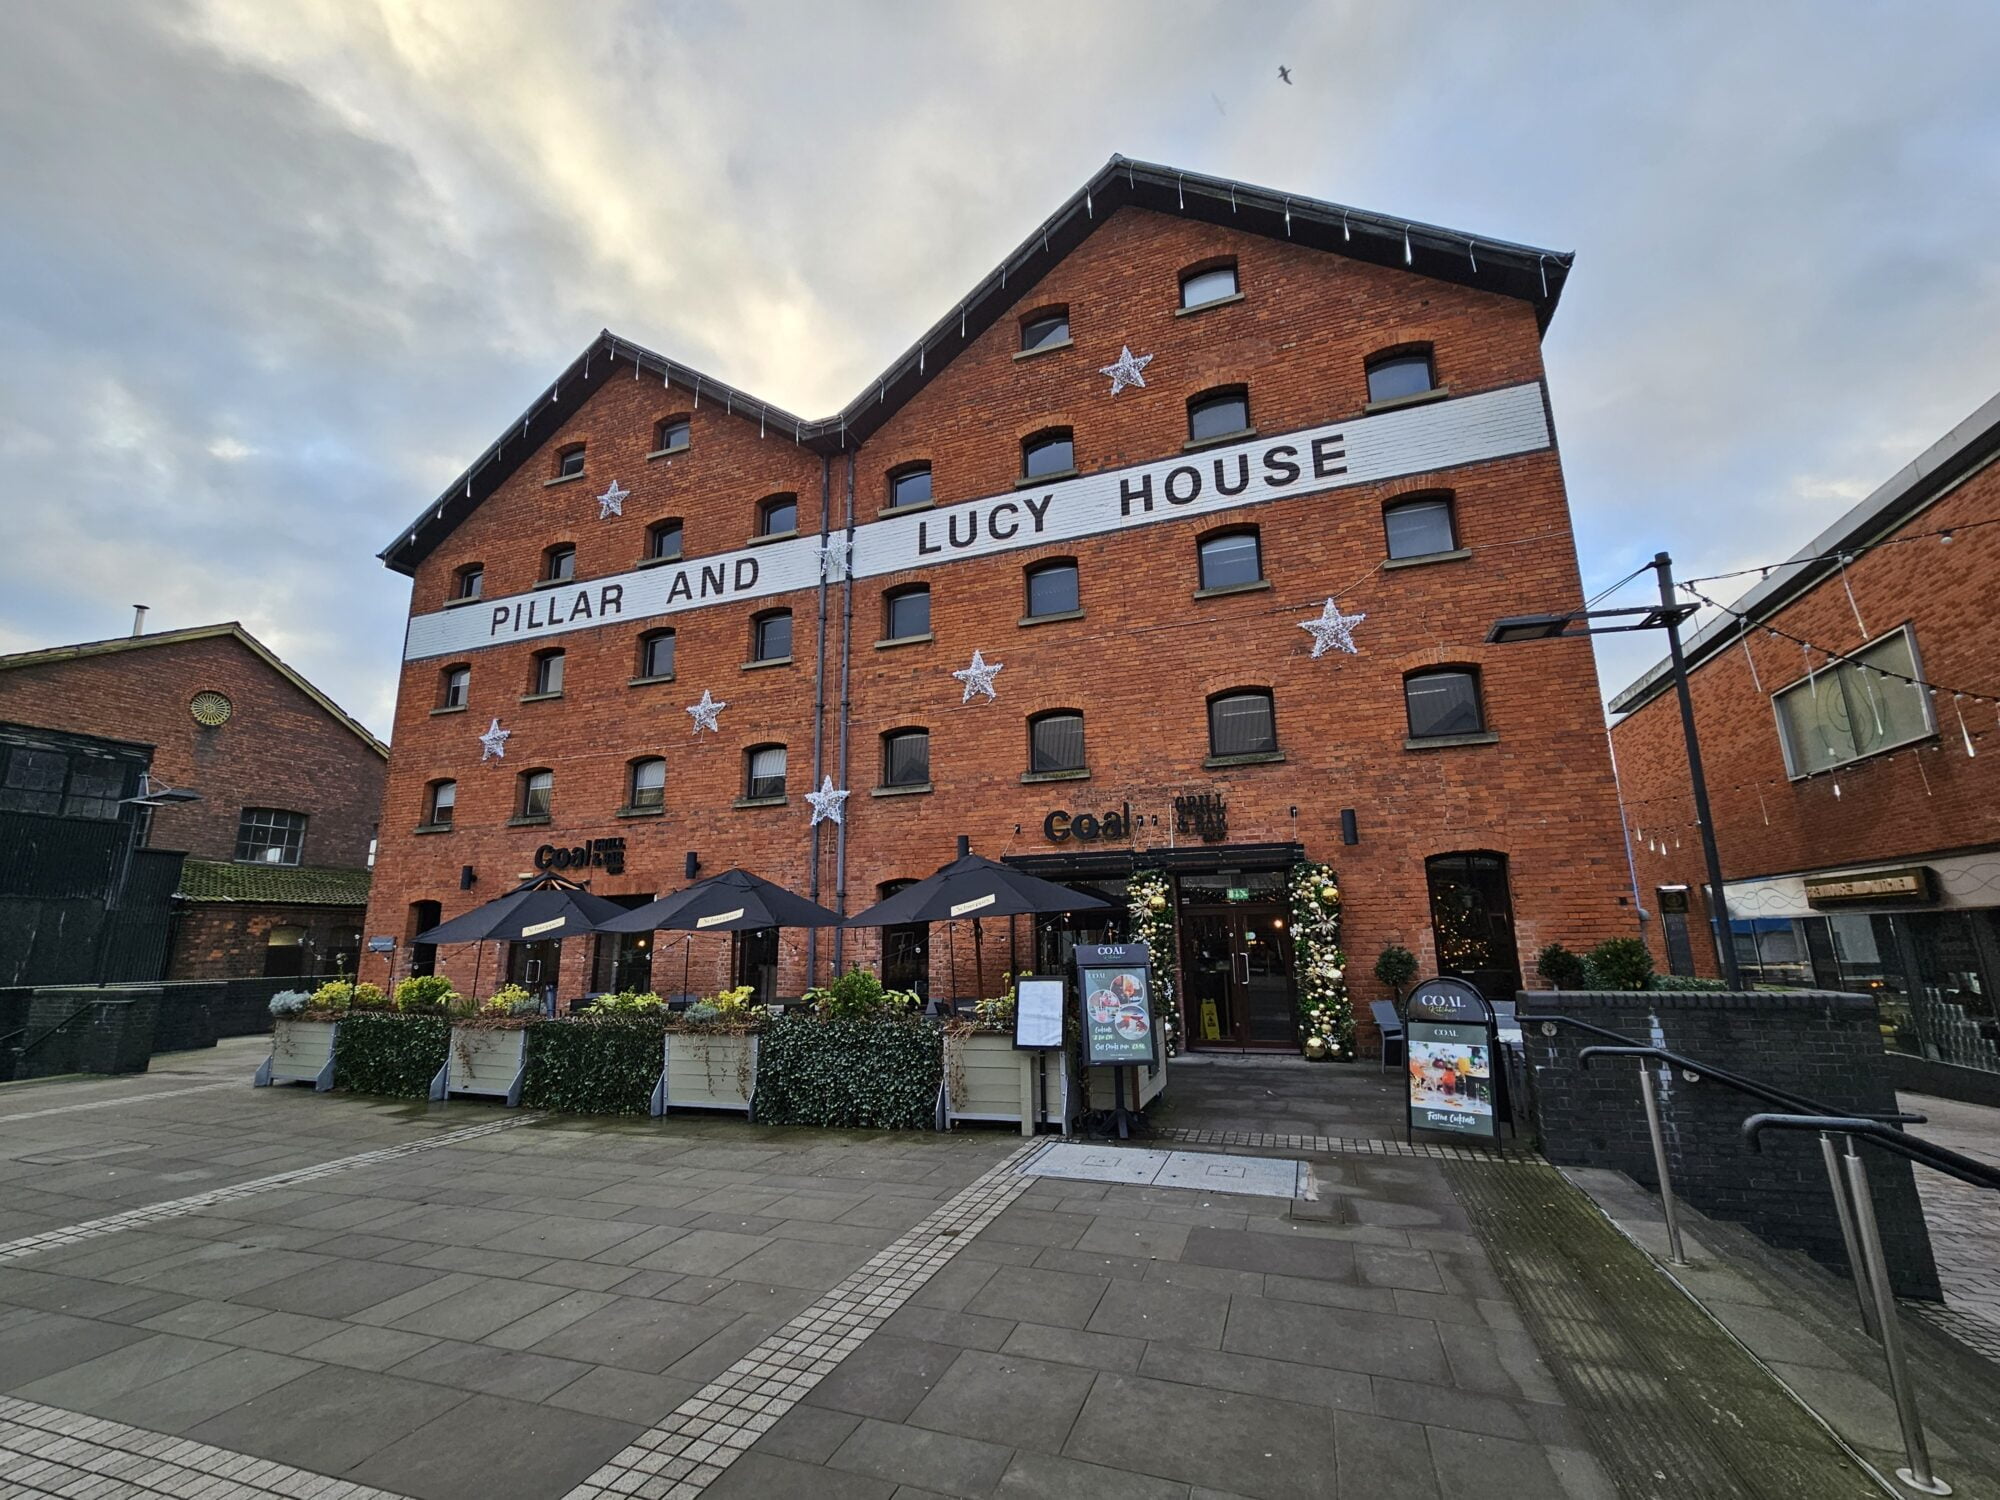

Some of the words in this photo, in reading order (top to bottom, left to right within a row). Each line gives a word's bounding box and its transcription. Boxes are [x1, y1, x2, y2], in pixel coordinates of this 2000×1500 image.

[491, 584, 624, 635] PILLAR
[666, 557, 760, 604] AND
[918, 494, 1054, 555] LUCY
[1120, 433, 1348, 516] HOUSE
[1044, 801, 1131, 842] Coal
[534, 840, 593, 869] Coal
[1097, 946, 1126, 955] COAL
[1421, 994, 1466, 1008] COAL
[1434, 1028, 1459, 1037] COAL
